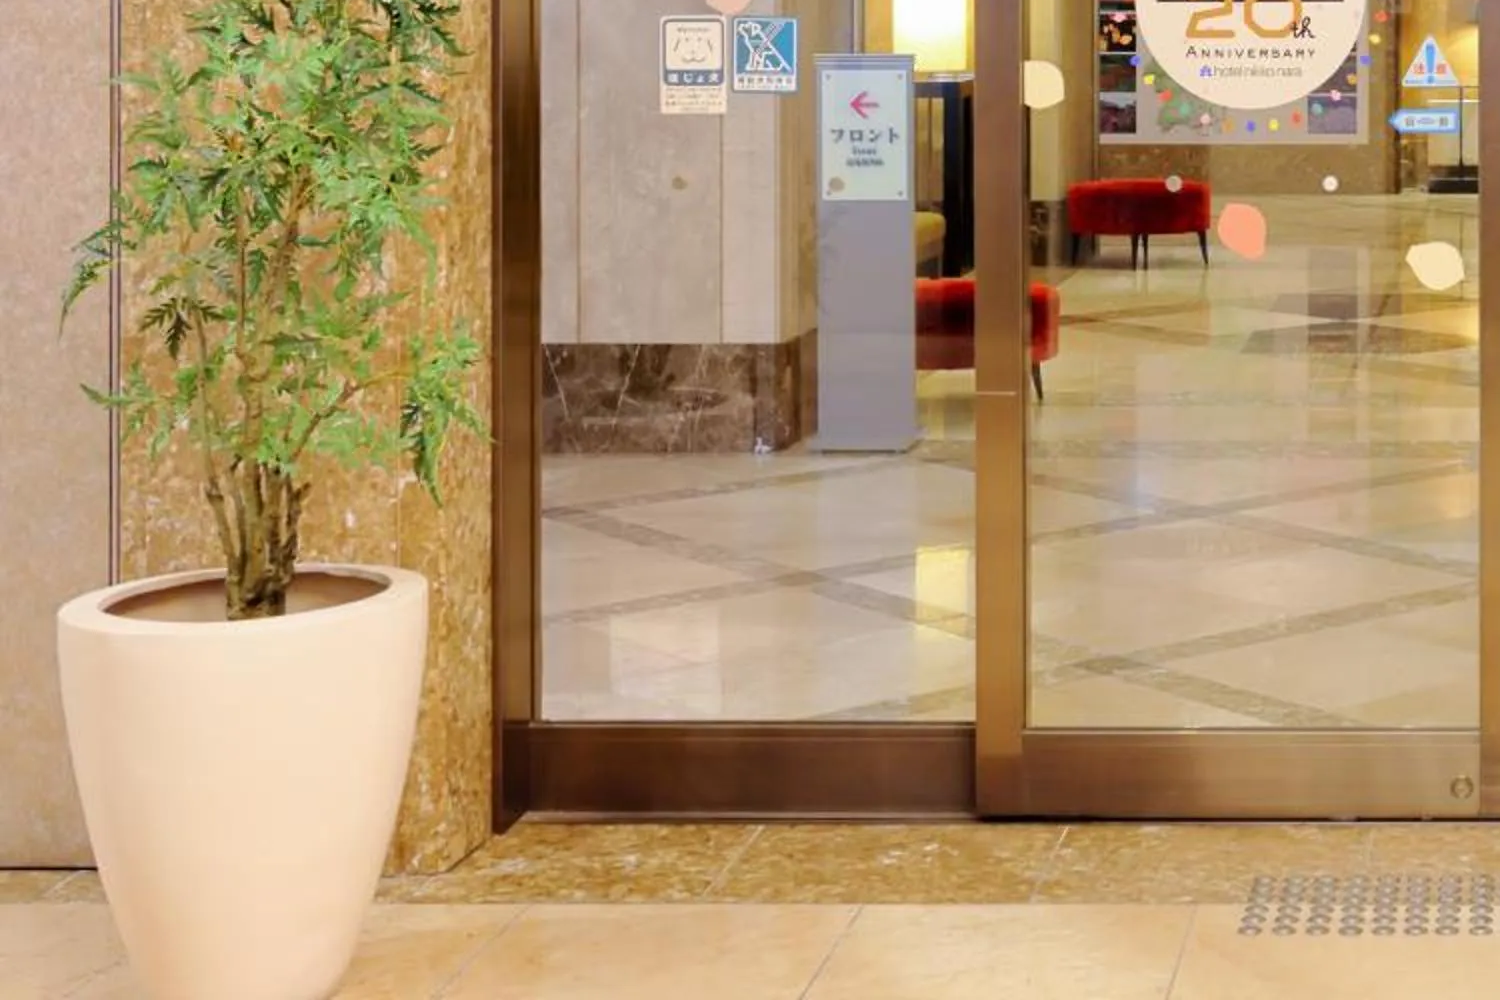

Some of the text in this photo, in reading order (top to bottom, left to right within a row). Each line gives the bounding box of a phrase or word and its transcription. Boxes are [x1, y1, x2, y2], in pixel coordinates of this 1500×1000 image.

[1185, 46, 1316, 59] ANNIVERSARY
[830, 127, 900, 144] フロント
